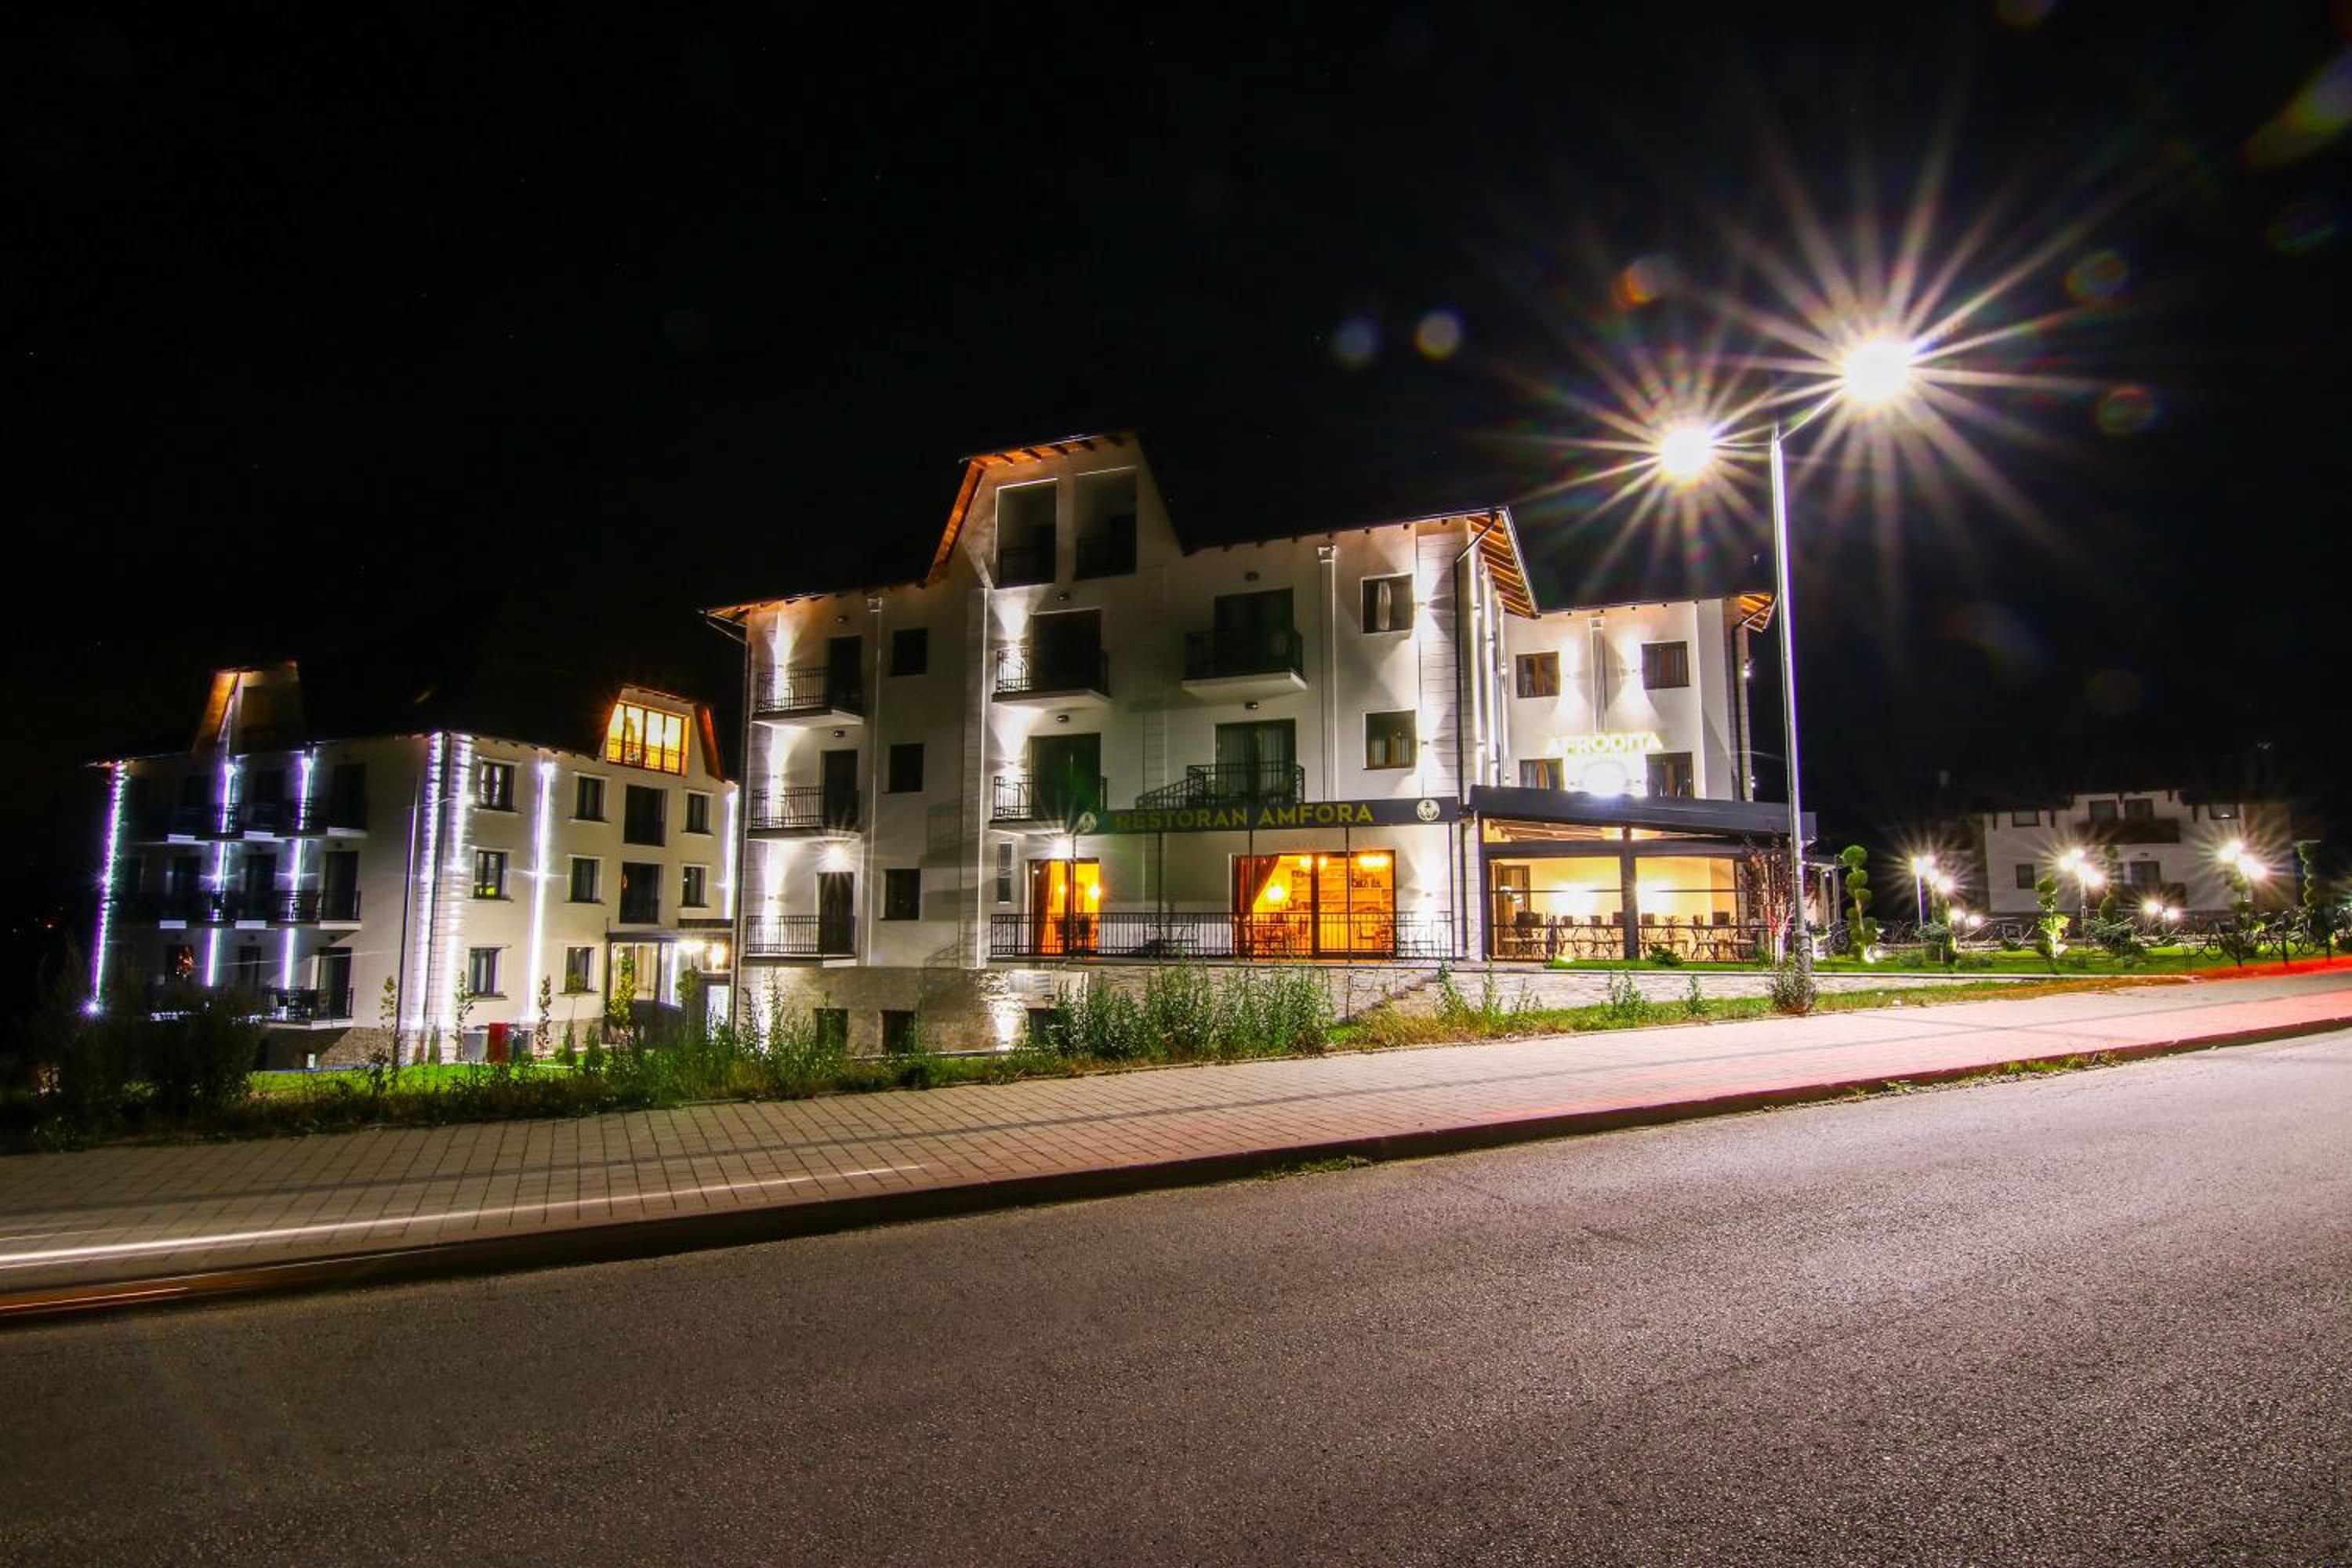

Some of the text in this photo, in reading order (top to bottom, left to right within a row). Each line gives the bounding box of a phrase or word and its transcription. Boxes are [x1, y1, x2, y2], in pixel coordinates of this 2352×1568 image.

[1544, 731, 1664, 755] AFRODITA
[1116, 803, 1374, 829] RESTORAN AMFORA
